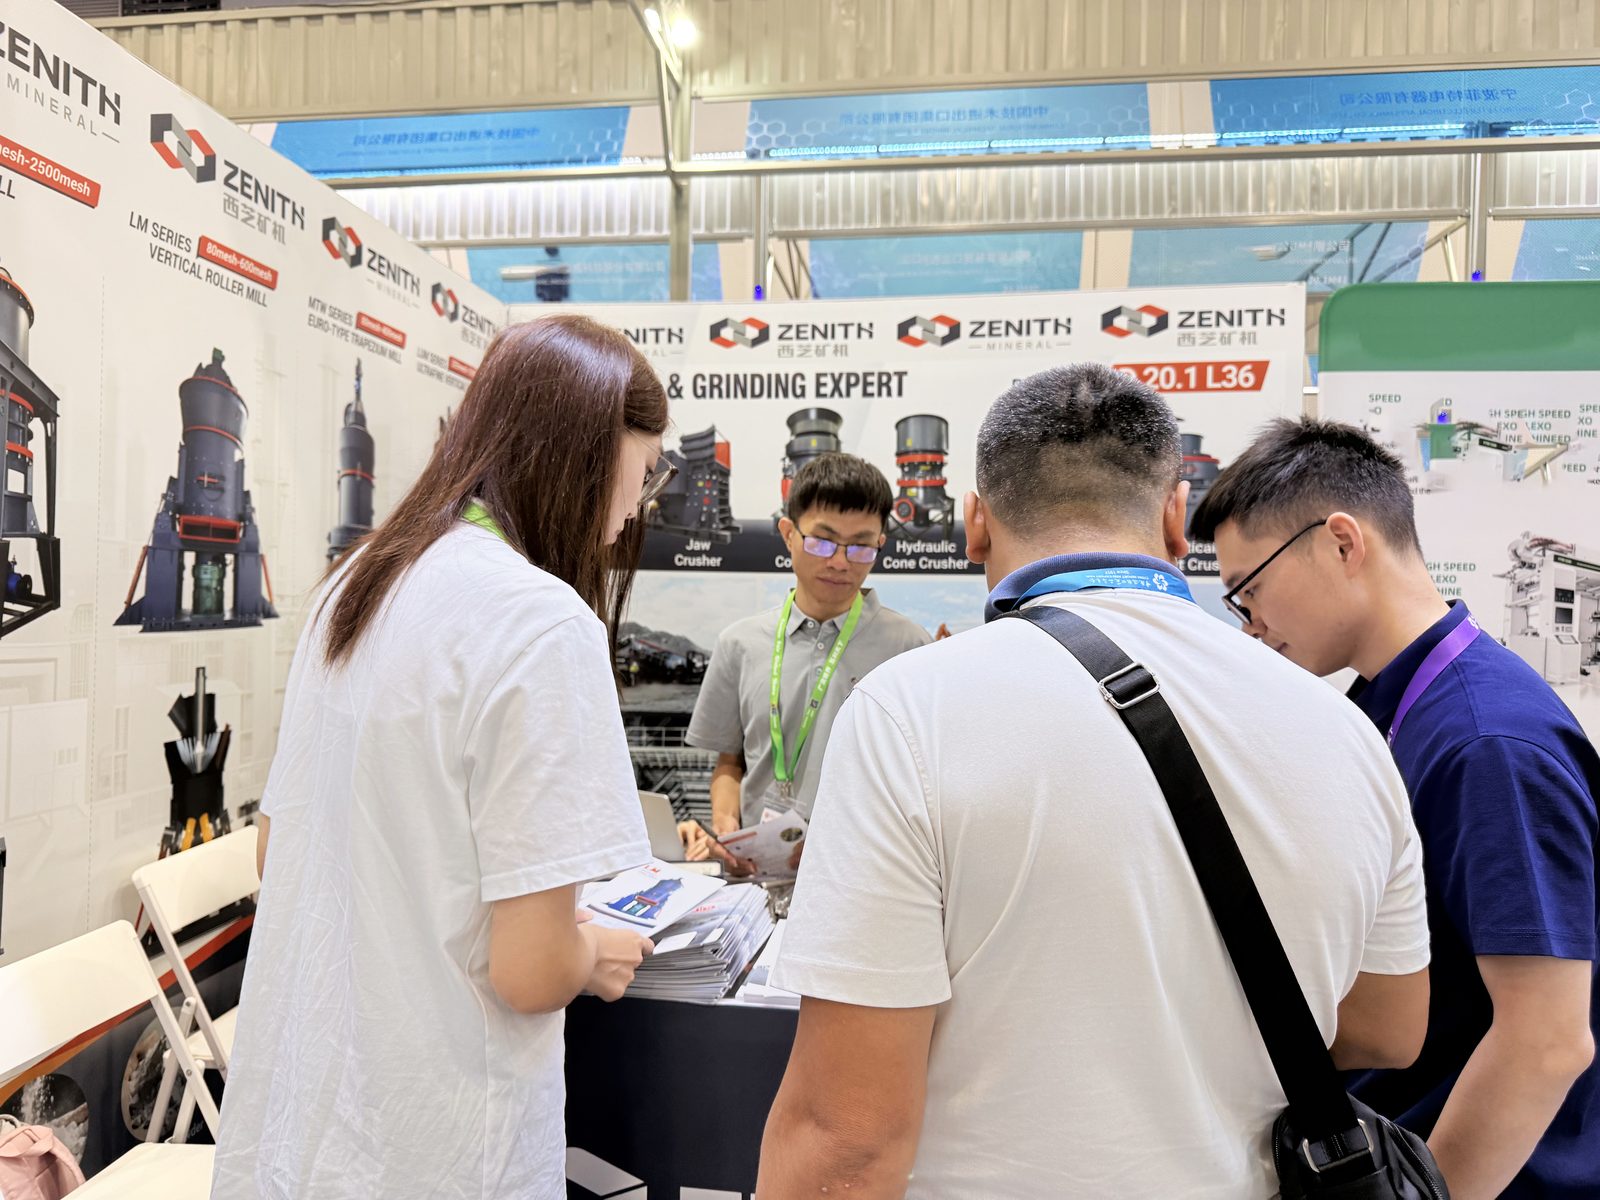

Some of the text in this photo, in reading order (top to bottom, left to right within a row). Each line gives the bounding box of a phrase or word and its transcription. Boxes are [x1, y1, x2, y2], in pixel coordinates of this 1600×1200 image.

[0, 21, 120, 126] ENITH
[7, 73, 97, 136] MINERAL
[223, 159, 304, 231] ZENITH
[223, 192, 286, 246] 西芝矿机
[129, 211, 149, 233] LM
[151, 222, 192, 253] SERIES
[149, 242, 268, 308] VERTICAL ROLLER MILL
[367, 248, 420, 298] ZENITH
[308, 295, 353, 327] MTW SERIES
[1177, 308, 1286, 328] ZENITH
[623, 328, 683, 344] NITH
[777, 322, 874, 341] ZENITH
[968, 317, 1072, 338] ZENITH
[986, 340, 1052, 351] MINERAL
[1177, 331, 1258, 347] 西芝矿机
[777, 344, 849, 359] 西芝矿机
[667, 371, 908, 399] & GRINDING EXPERT
[1206, 363, 1256, 389] L36
[1368, 394, 1401, 403] SPEED
[1538, 409, 1571, 418] SPEED
[686, 539, 711, 552] Jaw
[896, 540, 957, 555] Hydraulic
[674, 554, 722, 568] Crusher
[883, 556, 969, 570] Cone Crusher
[1443, 562, 1476, 571] SPEED
